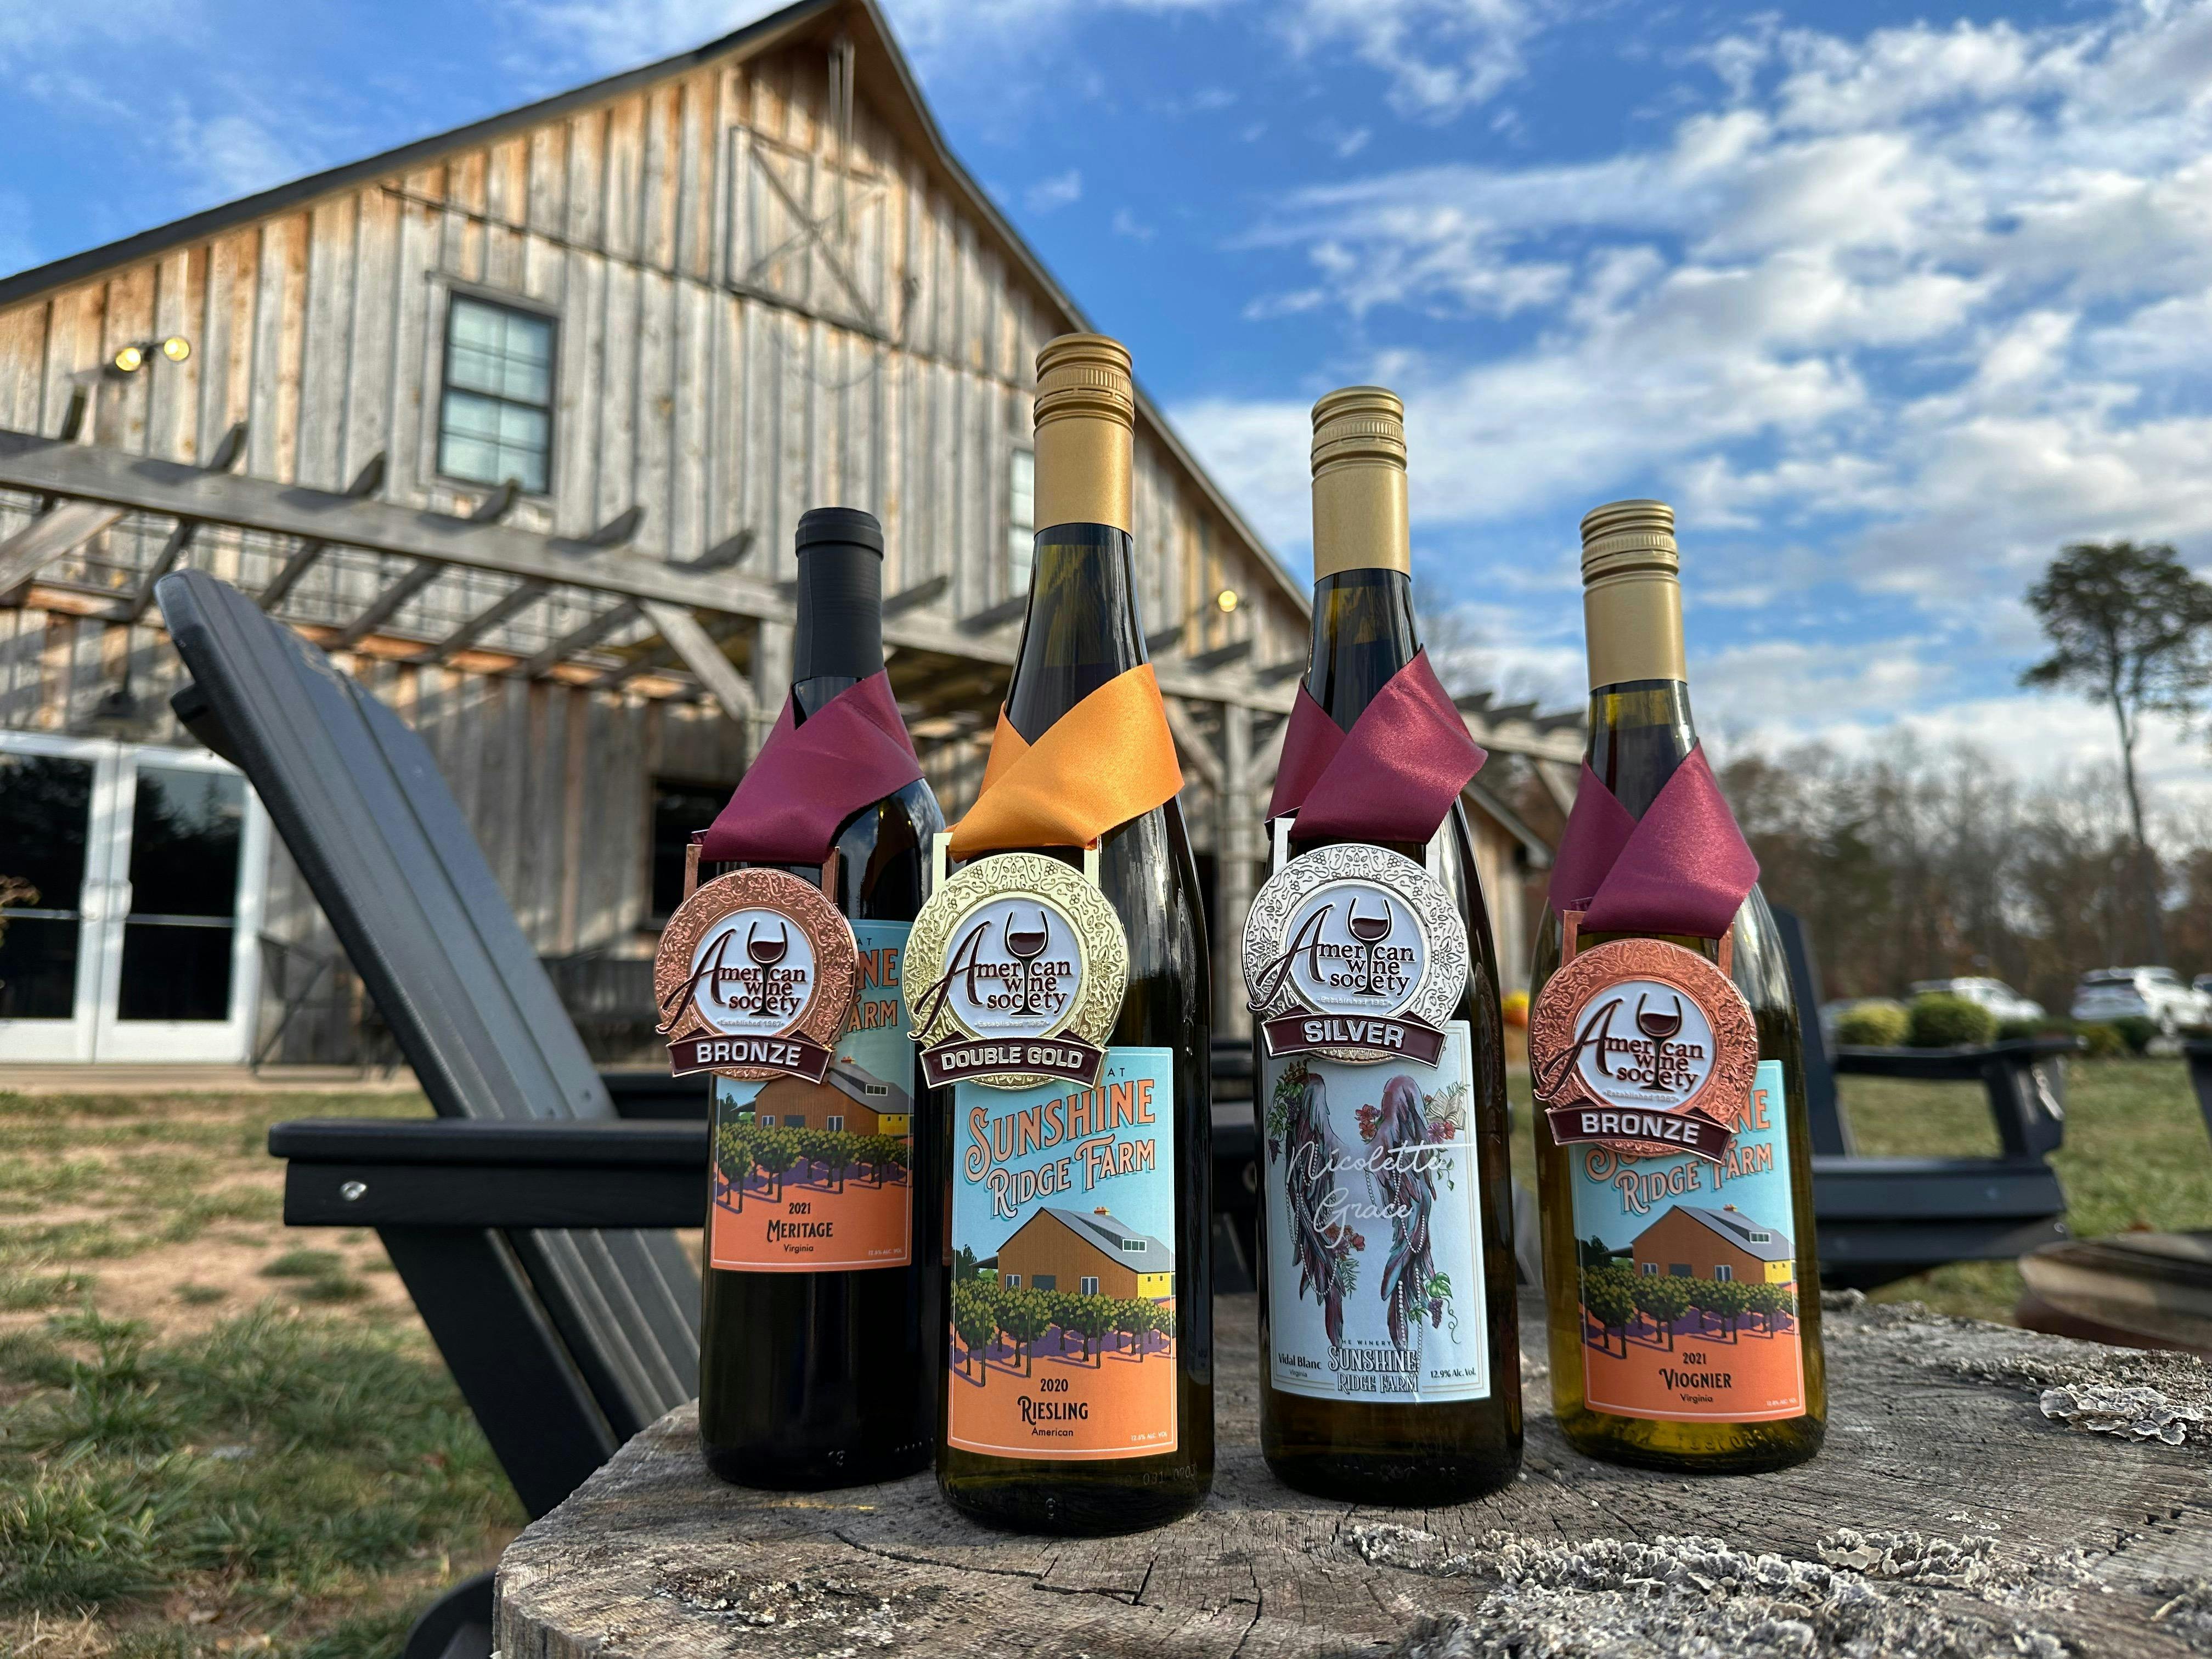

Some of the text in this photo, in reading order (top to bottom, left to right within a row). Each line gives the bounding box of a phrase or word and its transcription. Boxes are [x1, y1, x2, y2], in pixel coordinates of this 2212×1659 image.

[847, 994, 899, 1033] ARM
[1304, 1020, 1405, 1048] SILVER
[696, 1041, 803, 1067] BRONZE
[941, 1046, 1084, 1071] DOUBLE GOLD
[1107, 1068, 1125, 1077] AT
[964, 1079, 1156, 1183] SUNSHINE
[1581, 1112, 1701, 1145] BRONZE
[1286, 1140, 1476, 1184] Nicolette
[987, 1133, 1156, 1218] RIDGE FARM
[1614, 1161, 1701, 1214] RIDGE
[789, 1202, 811, 1215] 2021
[1313, 1188, 1413, 1249] Grace
[767, 1219, 834, 1243] MERITAGE
[783, 1244, 814, 1254] Virginia
[1278, 1352, 1322, 1370] Vidal Blanc
[1328, 1345, 1418, 1372] SUNSHINE
[1683, 1352, 1706, 1364] 2021
[1040, 1378, 1069, 1392] 2020
[1337, 1372, 1419, 1395] RIDGE FARM
[1430, 1369, 1451, 1378] 12.9%
[1659, 1368, 1731, 1390] VIOGNIER
[1017, 1395, 1088, 1426] RIESLING
[1680, 1393, 1713, 1404] Virginia
[1031, 1426, 1074, 1437] American
